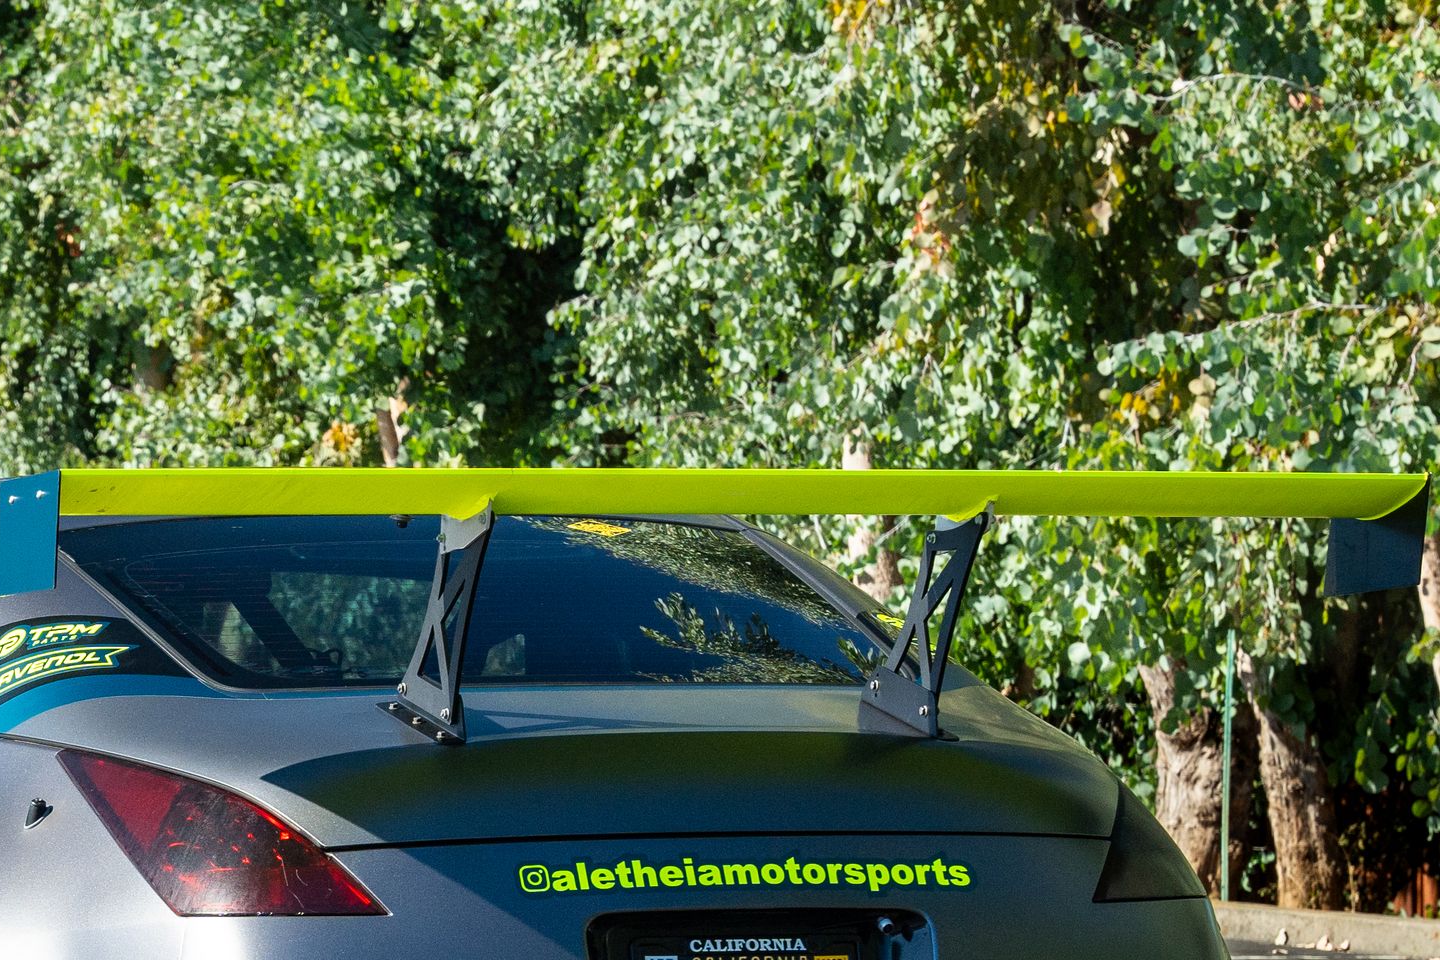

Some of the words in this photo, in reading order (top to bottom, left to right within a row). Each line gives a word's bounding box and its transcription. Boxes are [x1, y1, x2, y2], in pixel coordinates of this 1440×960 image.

[29, 623, 103, 641] TPM
[32, 634, 78, 647] PARTS
[689, 938, 807, 953] CALIFORNIA
